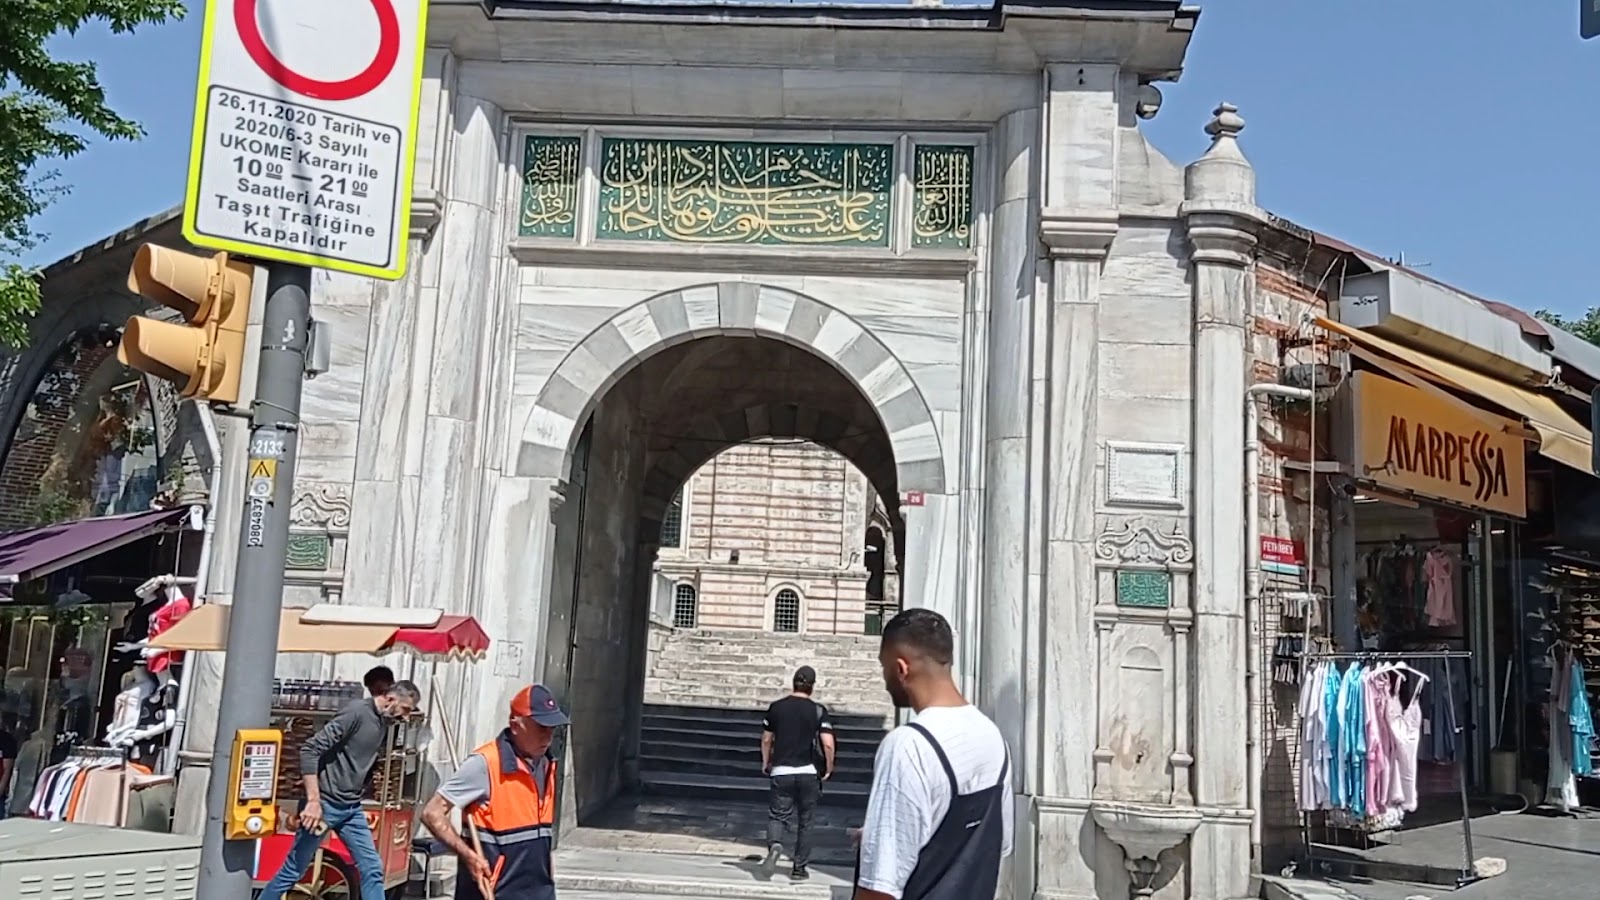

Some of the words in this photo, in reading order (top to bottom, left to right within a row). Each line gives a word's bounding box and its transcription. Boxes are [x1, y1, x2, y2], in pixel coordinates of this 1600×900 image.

[217, 92, 316, 126] 26.11.2020
[322, 115, 366, 139] Tarih
[372, 130, 391, 144] ve
[235, 116, 313, 146] 2020/6-3
[318, 135, 368, 158] Sayılı
[219, 132, 293, 161] UKOME
[298, 150, 353, 175] Kararı
[358, 165, 378, 179] ile
[215, 194, 271, 218] Taşıt
[278, 206, 376, 237] Trafiğine
[237, 178, 309, 205] Saatleri
[313, 194, 361, 216] Arası
[244, 220, 348, 252] Kapalıdır
[1386, 415, 1509, 502] MARPESSA
